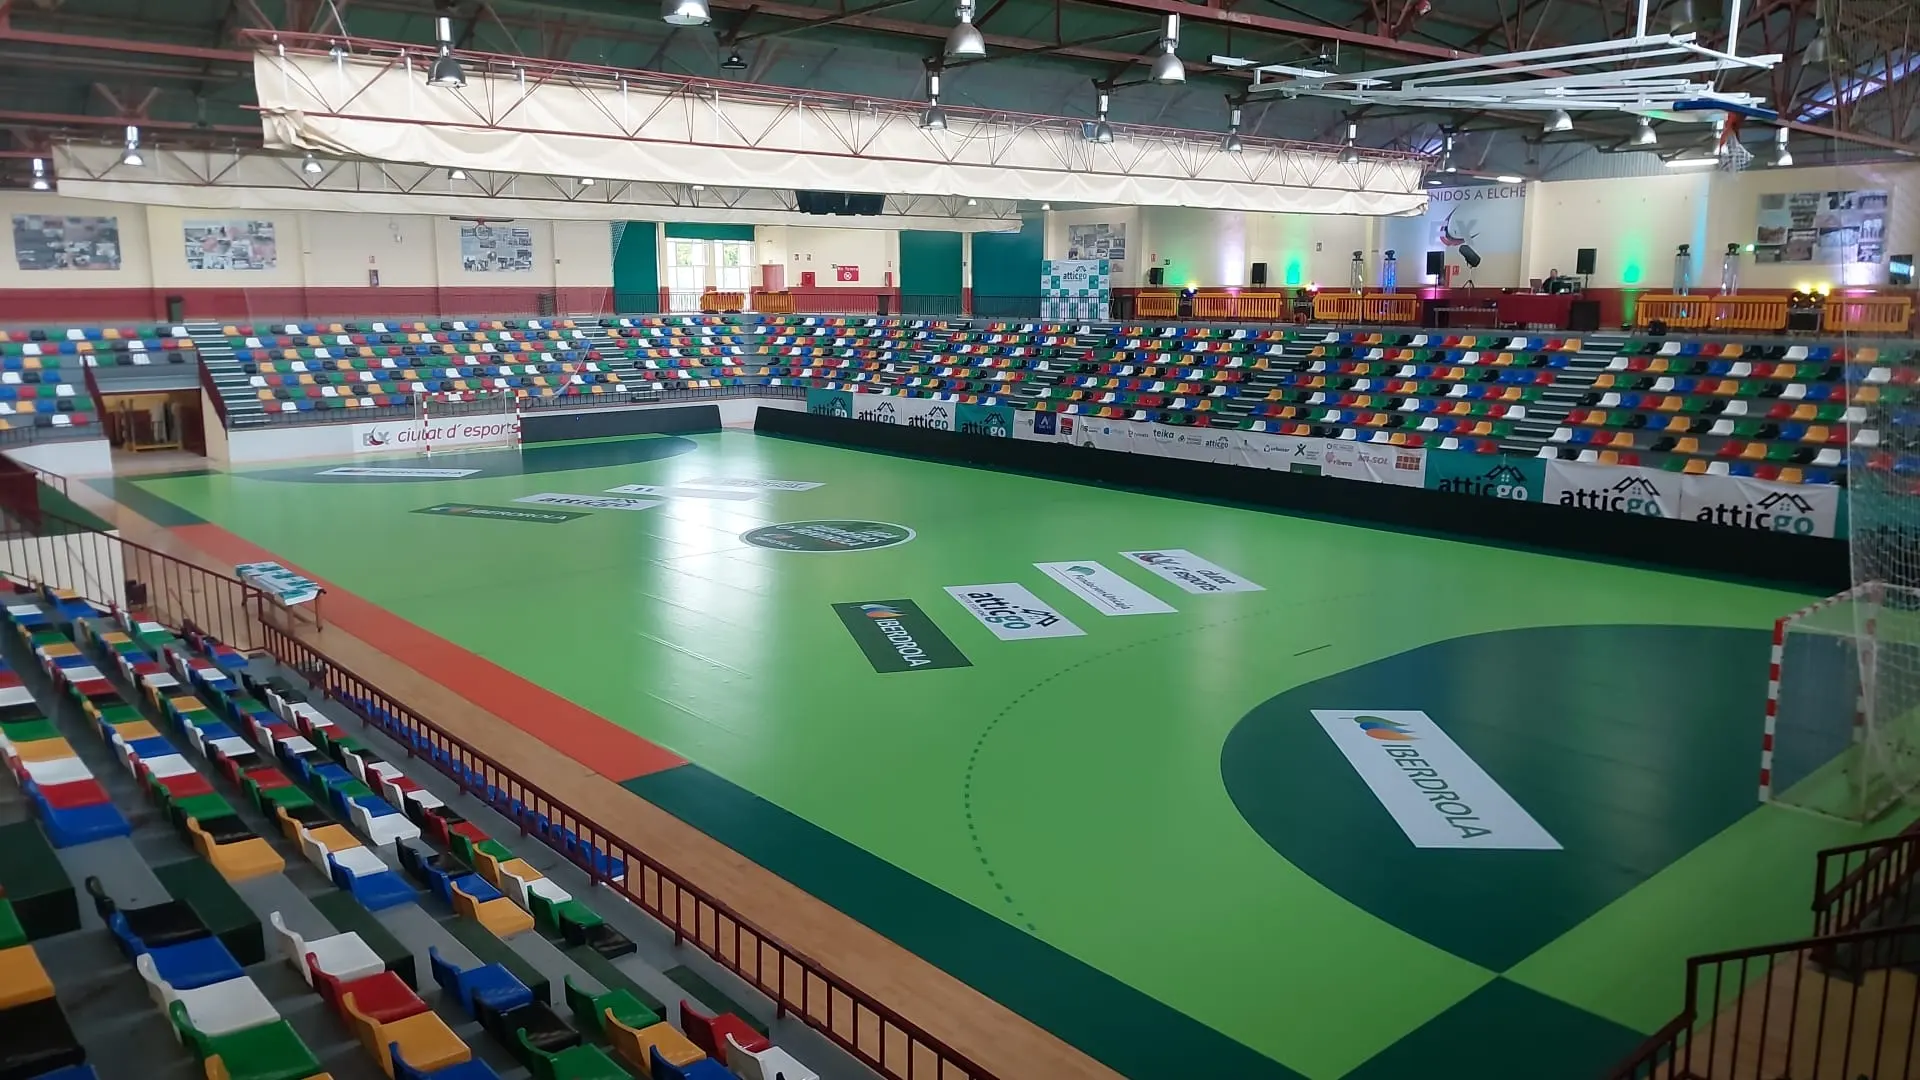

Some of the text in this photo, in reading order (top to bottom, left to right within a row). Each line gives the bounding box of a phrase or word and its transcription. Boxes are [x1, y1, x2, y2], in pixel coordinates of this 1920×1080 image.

[1427, 189, 1470, 202] NIDOS
[1487, 186, 1526, 199] ELCHE
[858, 408, 896, 423] atticgo
[908, 413, 949, 430] atticgo
[962, 421, 1006, 437] atticgo
[1153, 429, 1175, 439] teika
[1439, 474, 1528, 500] atticgo
[1560, 487, 1662, 516] atticgo
[1697, 502, 1815, 536] atticgo
[967, 591, 1031, 630] atticgo
[874, 618, 931, 667] IBERDROLA
[1381, 744, 1492, 839] IBERDROLA
